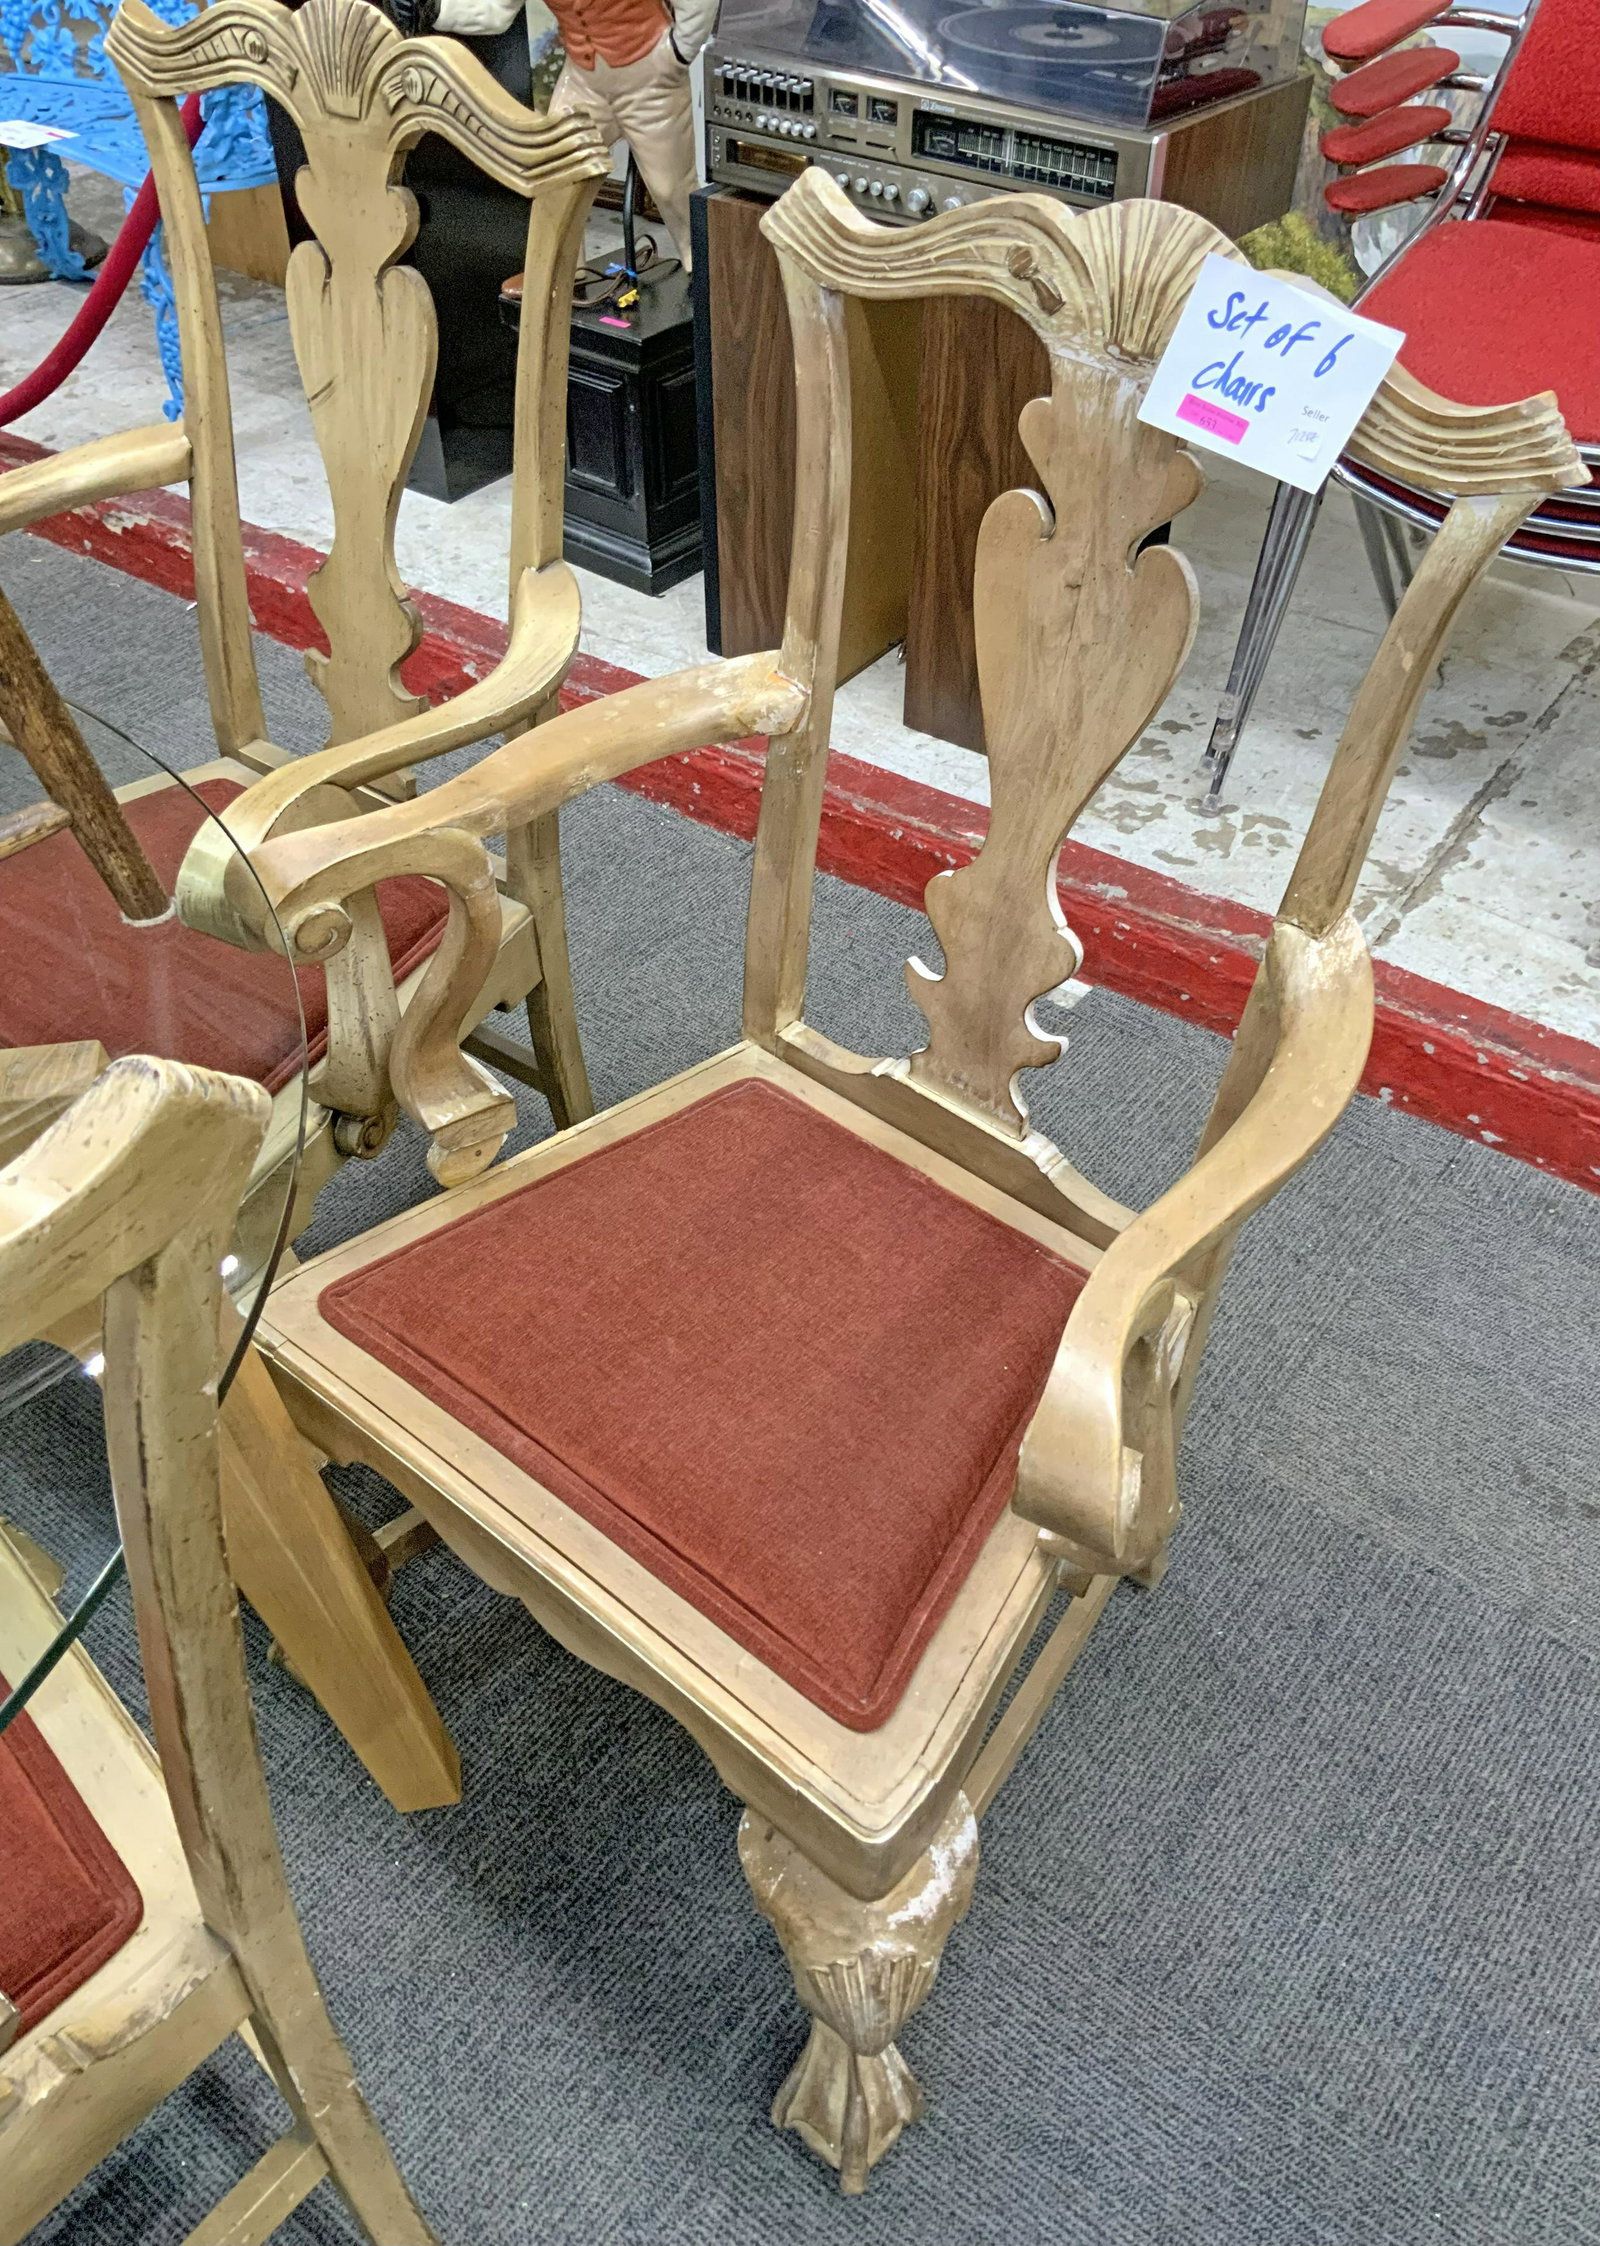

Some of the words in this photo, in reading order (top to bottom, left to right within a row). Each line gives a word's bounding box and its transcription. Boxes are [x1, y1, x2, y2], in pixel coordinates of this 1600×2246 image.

[1208, 291, 1269, 339] Set
[1313, 333, 1355, 378] 6
[1301, 405, 1330, 423] Seller
